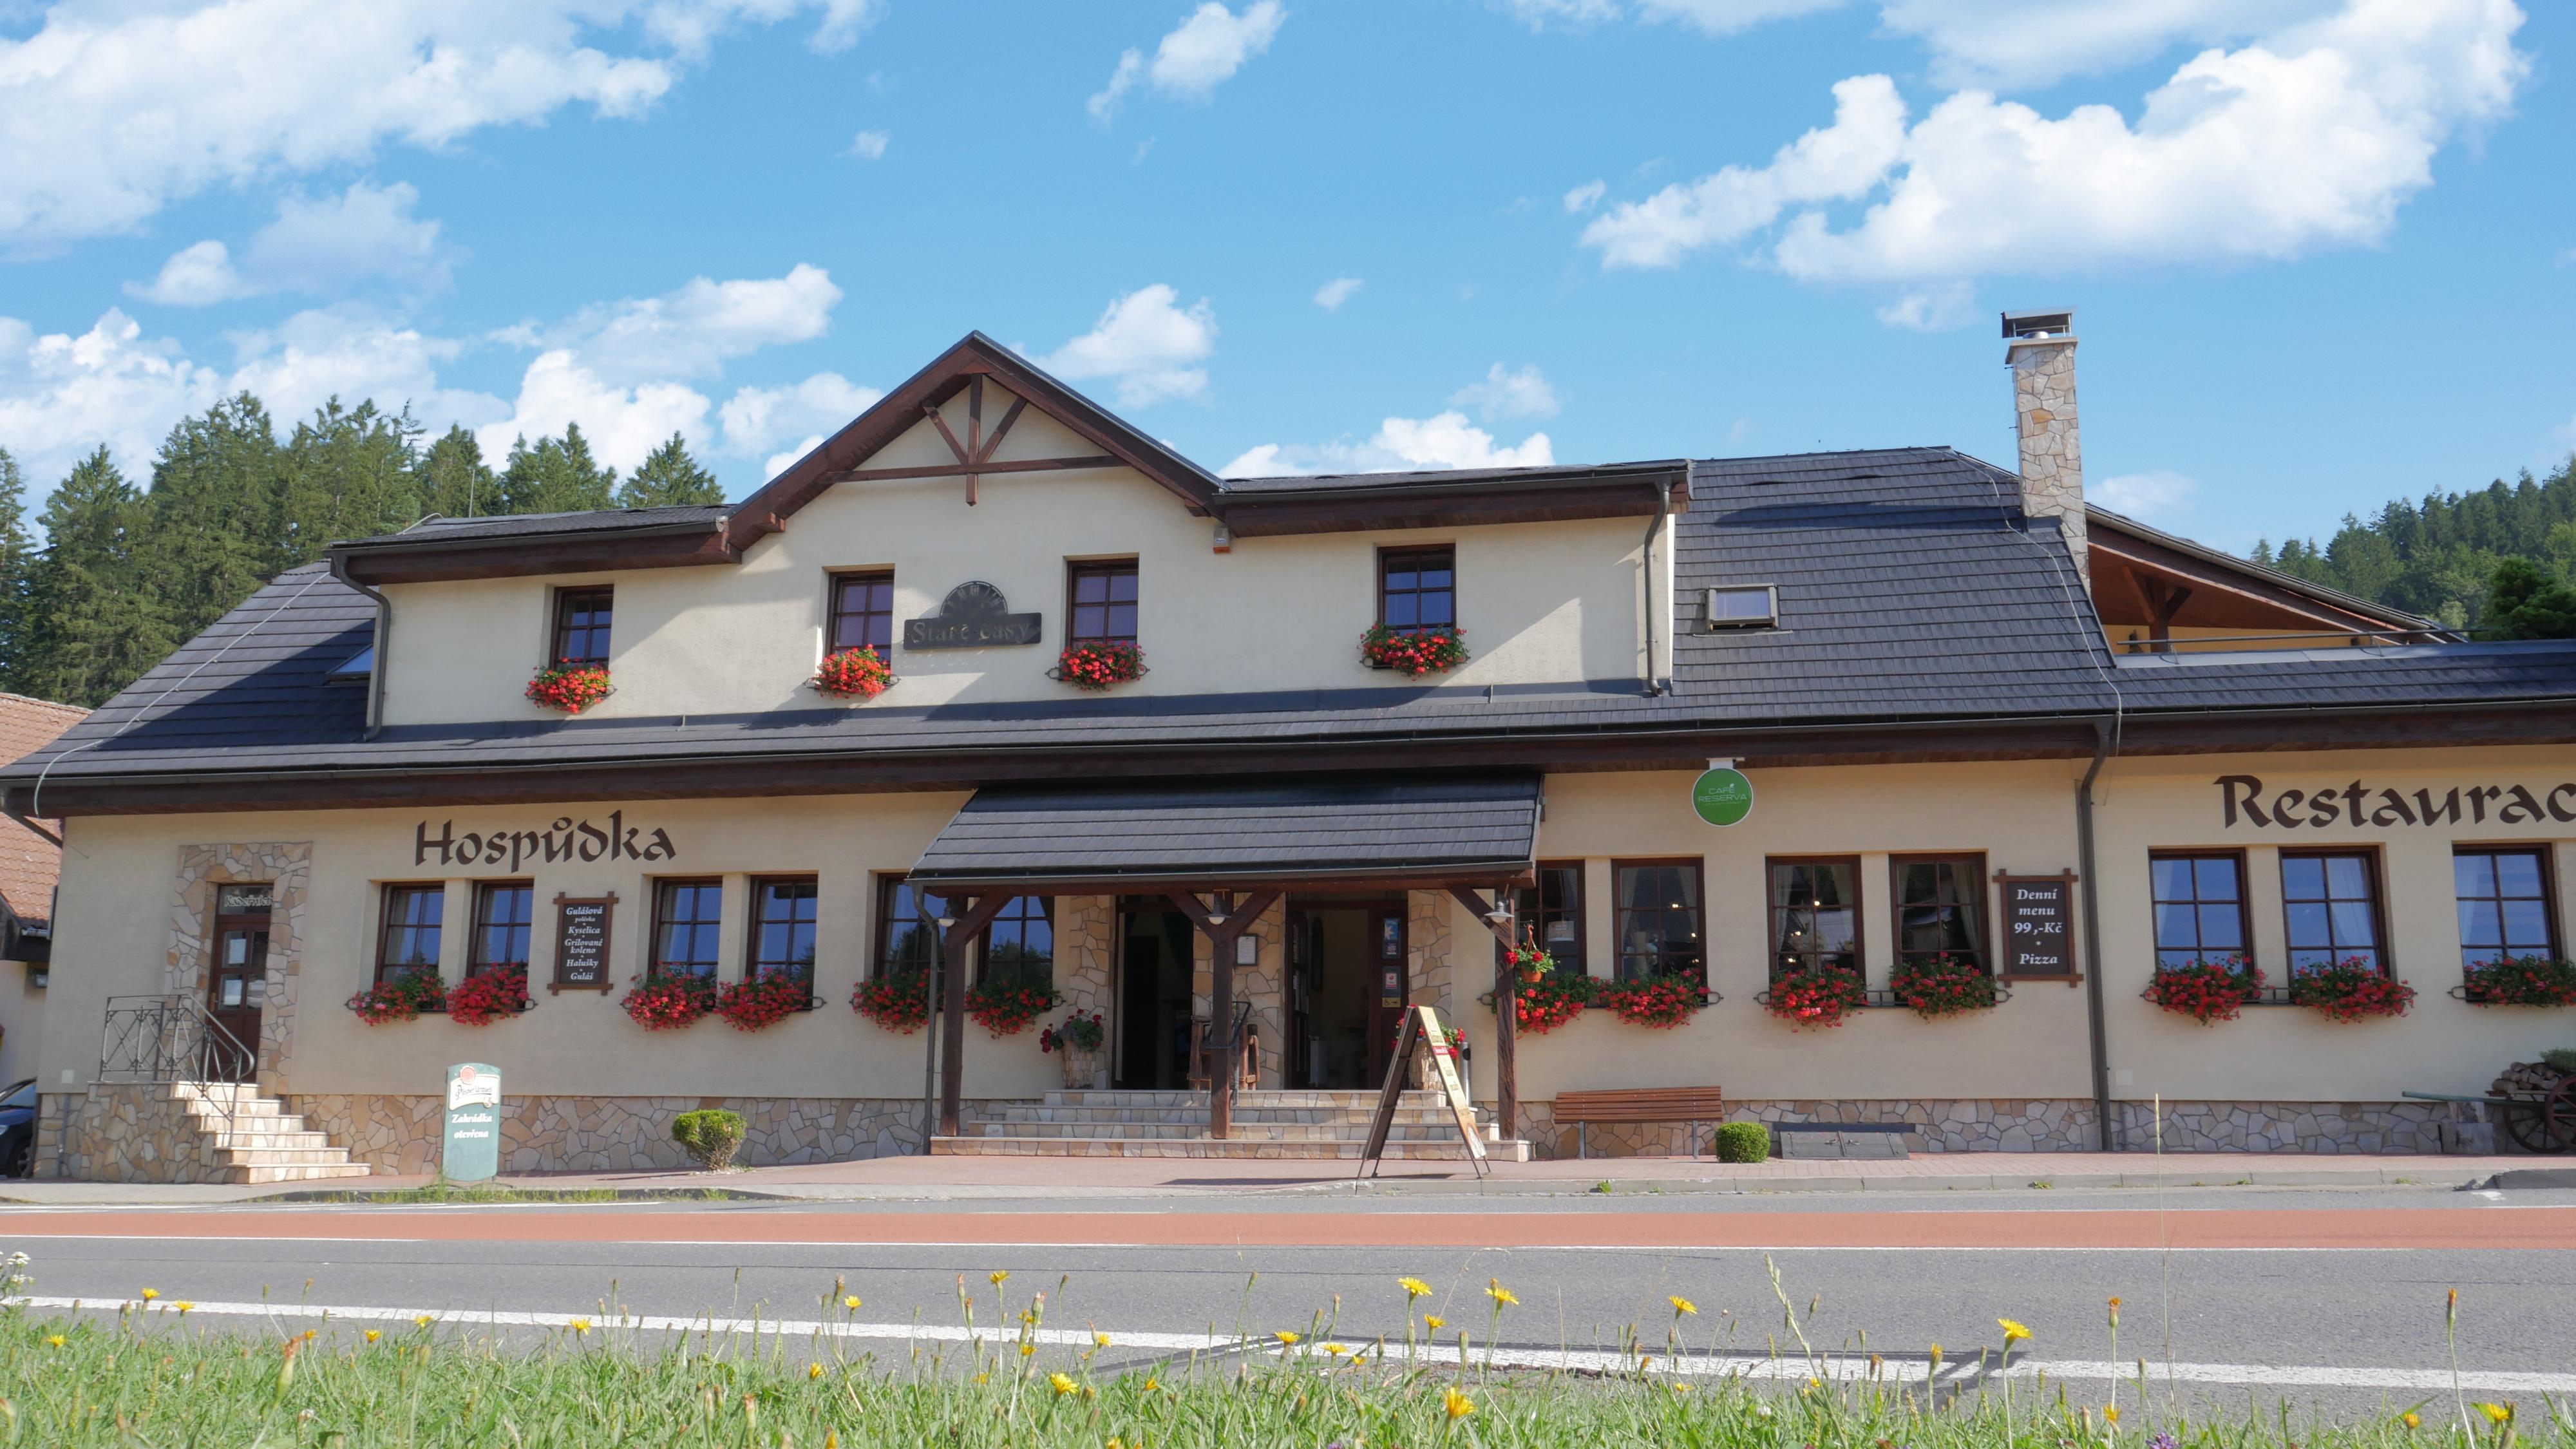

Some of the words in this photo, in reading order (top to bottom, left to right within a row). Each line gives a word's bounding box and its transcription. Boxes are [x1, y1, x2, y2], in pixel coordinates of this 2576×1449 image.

[1698, 794, 1747, 802] RESERVA
[415, 810, 677, 873] Hospůdka
[2016, 888, 2058, 900] Denní
[566, 906, 603, 915] Gulášová
[2018, 907, 2056, 916] menu
[568, 926, 600, 936] Kyselica
[564, 938, 603, 947] Grilované
[566, 958, 599, 969] Halušky
[2019, 953, 2059, 965] Pizza
[451, 1113, 492, 1124] Zahrádka
[454, 1130, 489, 1139] otevřena
